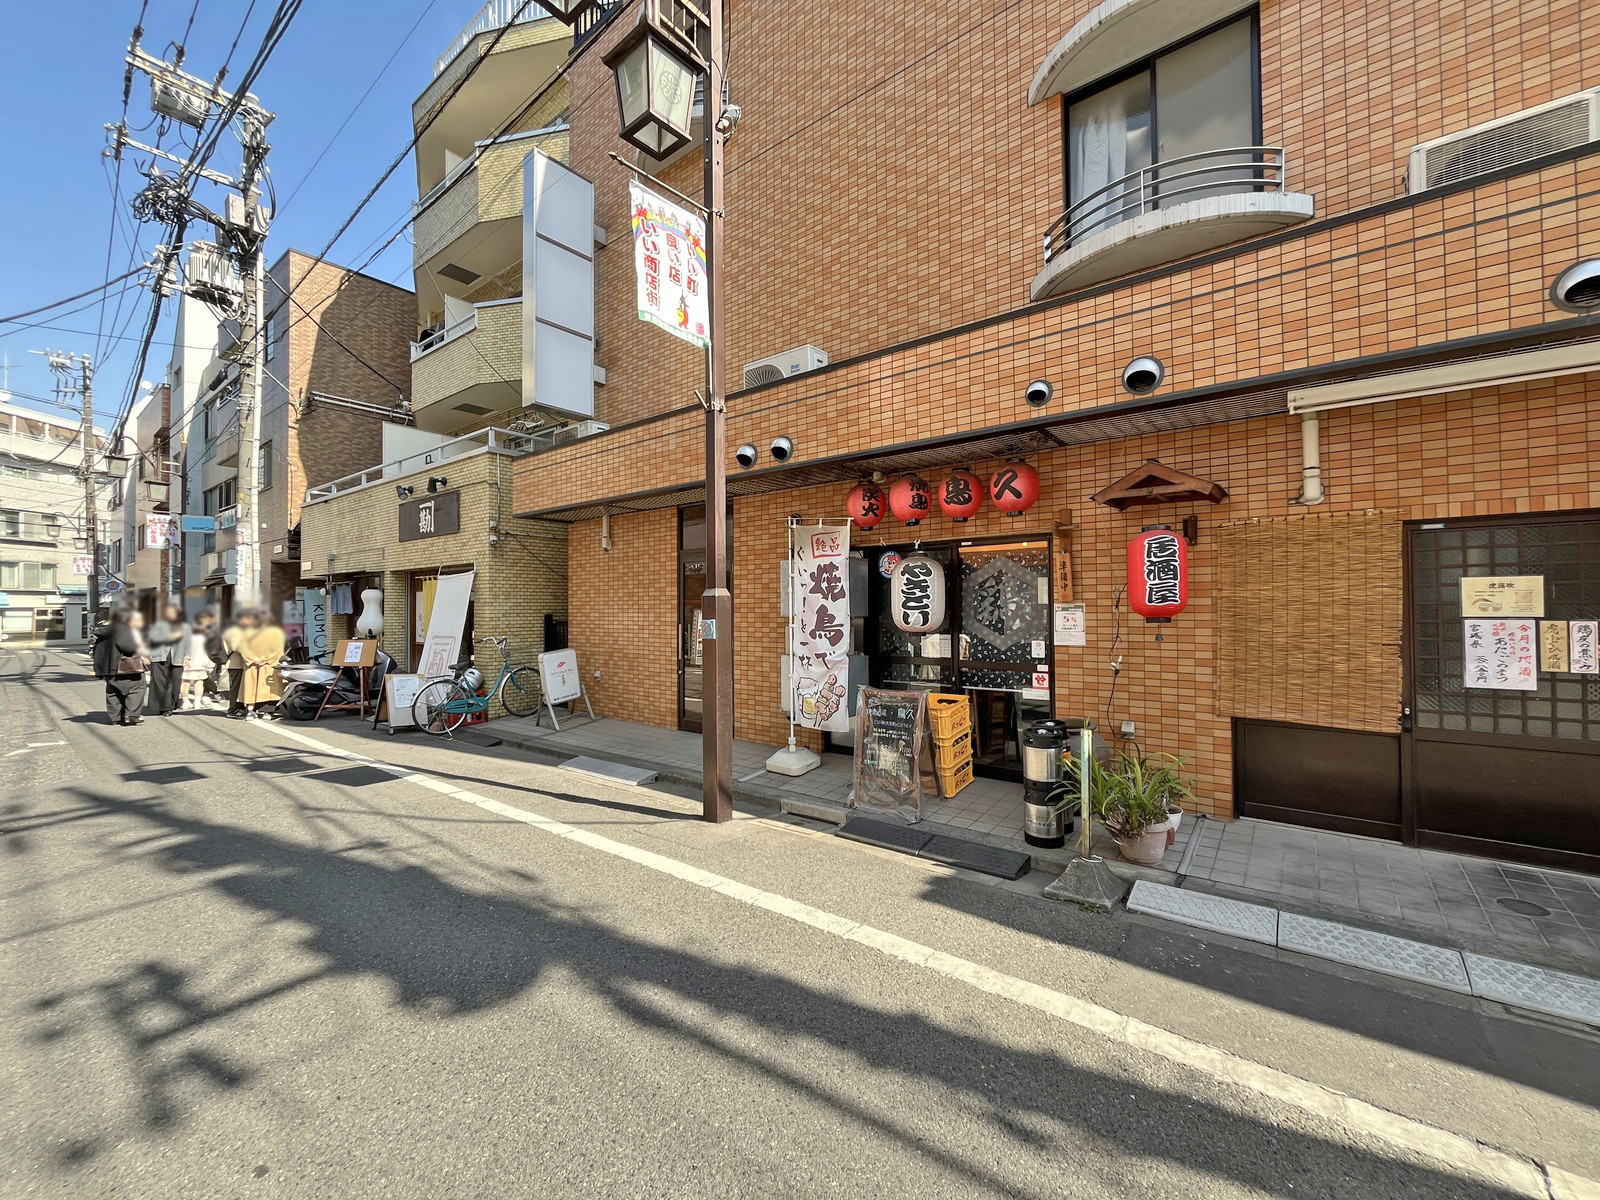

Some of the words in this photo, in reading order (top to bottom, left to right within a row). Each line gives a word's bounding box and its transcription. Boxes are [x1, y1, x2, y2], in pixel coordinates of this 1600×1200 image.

[640, 217, 661, 311] いい商店街
[665, 233, 683, 287] 良い店
[686, 240, 698, 296] いい町
[861, 488, 881, 518] 炭火
[908, 479, 929, 510] 焼鳥
[943, 476, 973, 506] 鳥
[993, 469, 1023, 500] 久
[815, 536, 840, 553] 絶品
[1059, 560, 1069, 592] 準備中
[1144, 535, 1180, 606] 居酒屋
[808, 561, 846, 670] 焼鳥で
[899, 561, 933, 628] やきとり
[1469, 624, 1484, 649] 宮城県
[1517, 624, 1532, 676] 今月の地酒
